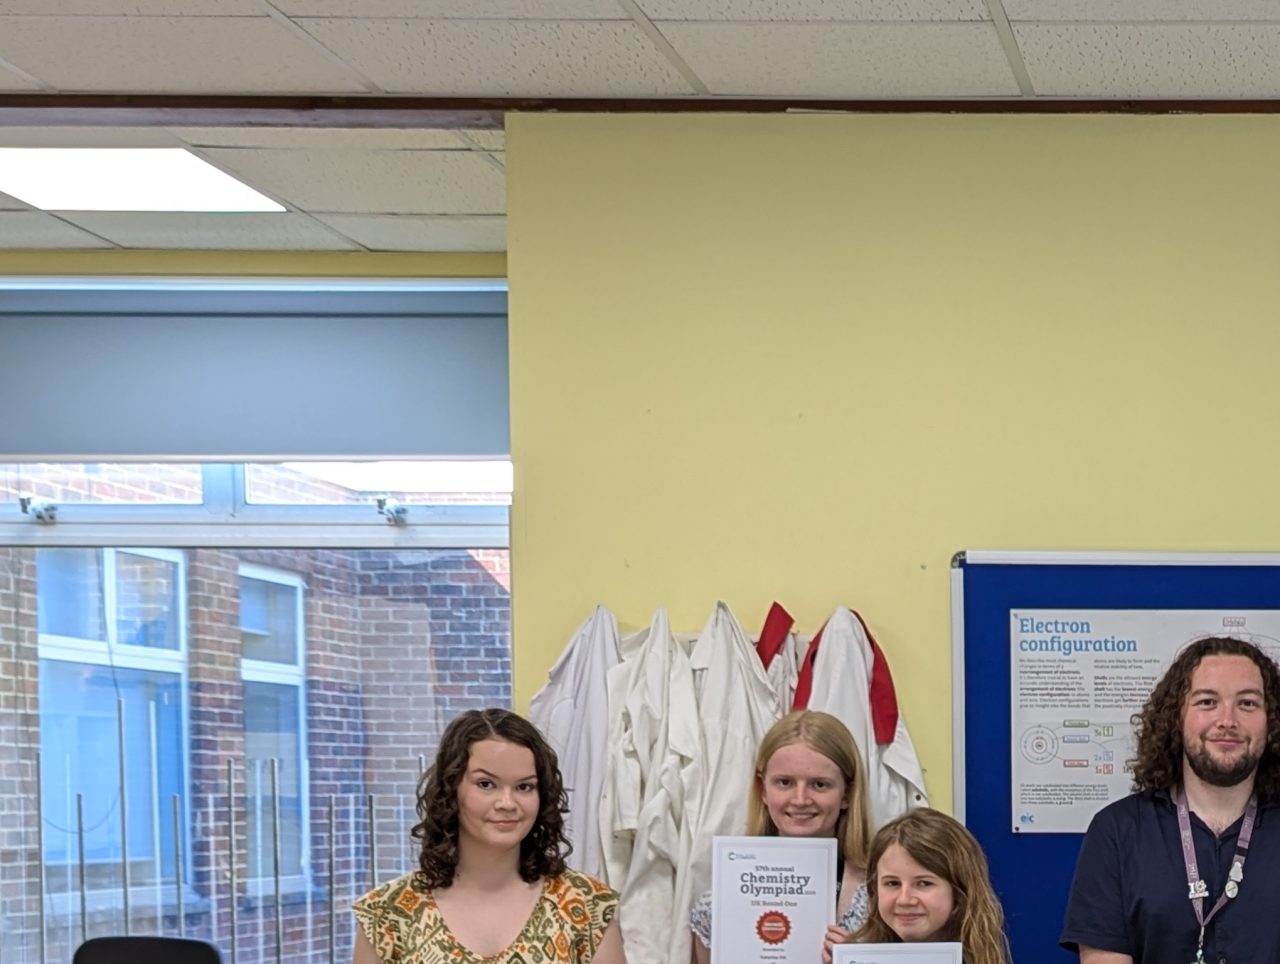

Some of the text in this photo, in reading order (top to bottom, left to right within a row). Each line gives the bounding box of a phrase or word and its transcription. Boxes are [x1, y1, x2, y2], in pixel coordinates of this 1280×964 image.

[1019, 617, 1091, 634] Electron
[1019, 636, 1138, 656] configuration
[771, 865, 795, 873] annual
[740, 872, 811, 888] Chemistry
[740, 883, 805, 898] Olympiad
